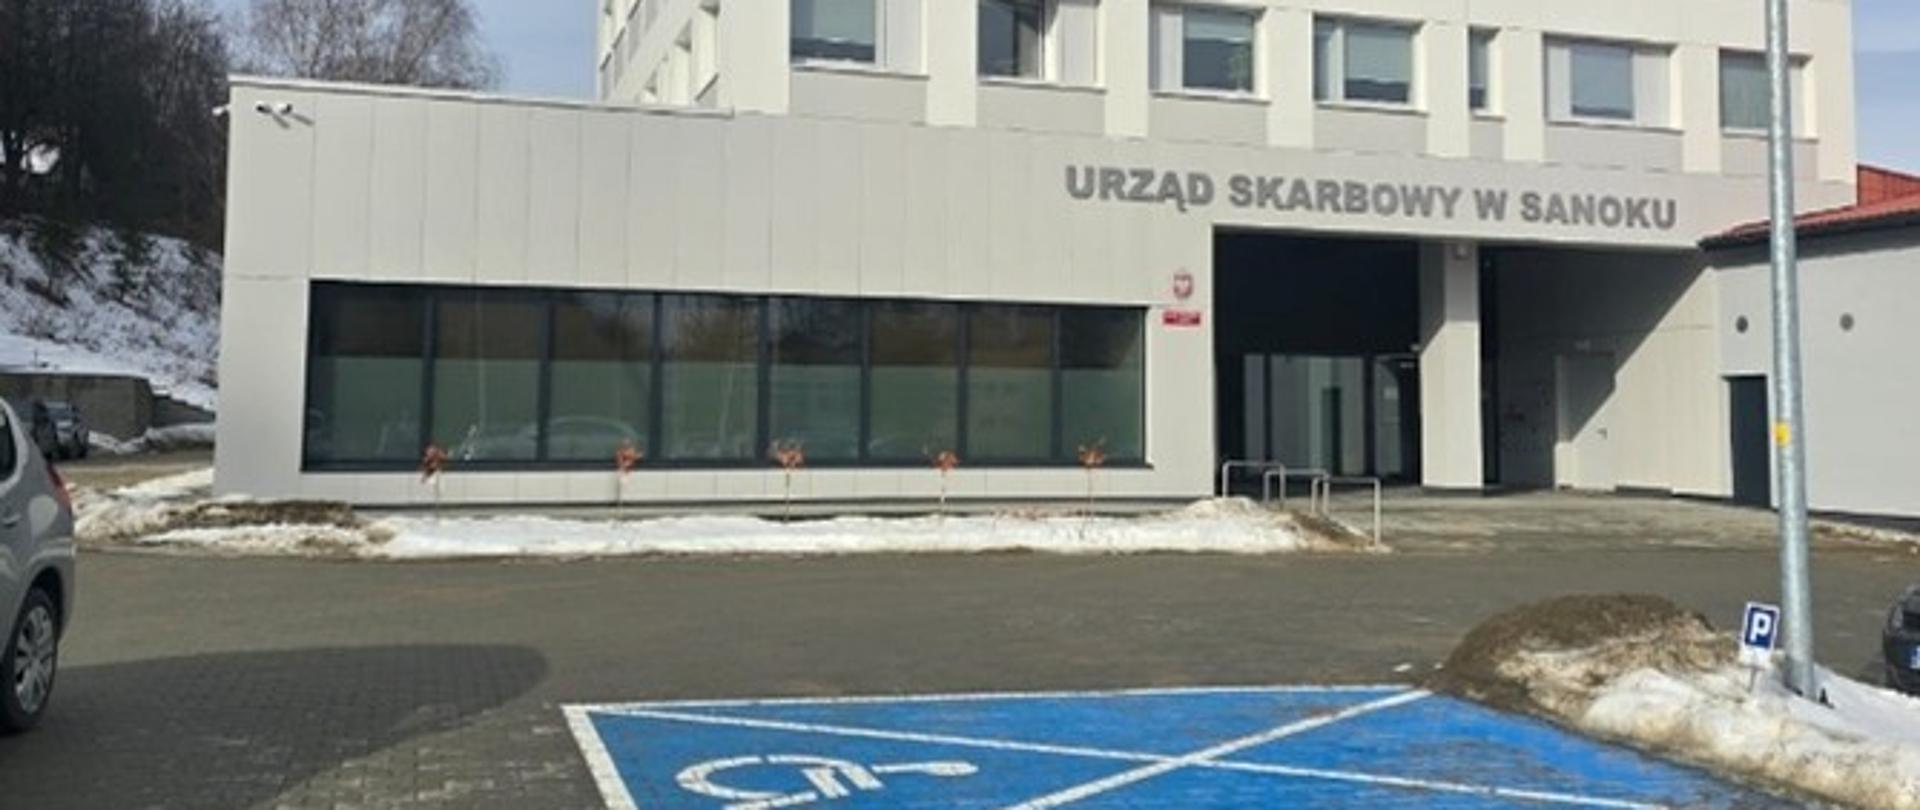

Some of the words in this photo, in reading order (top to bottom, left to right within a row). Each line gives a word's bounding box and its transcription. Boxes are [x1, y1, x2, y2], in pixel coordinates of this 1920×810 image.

[1065, 164, 1214, 212] URZĄD
[1229, 176, 1462, 219] SKARBOWY
[1474, 188, 1507, 221] W
[1520, 192, 1677, 229] SANOKU
[1750, 612, 1771, 642] P
